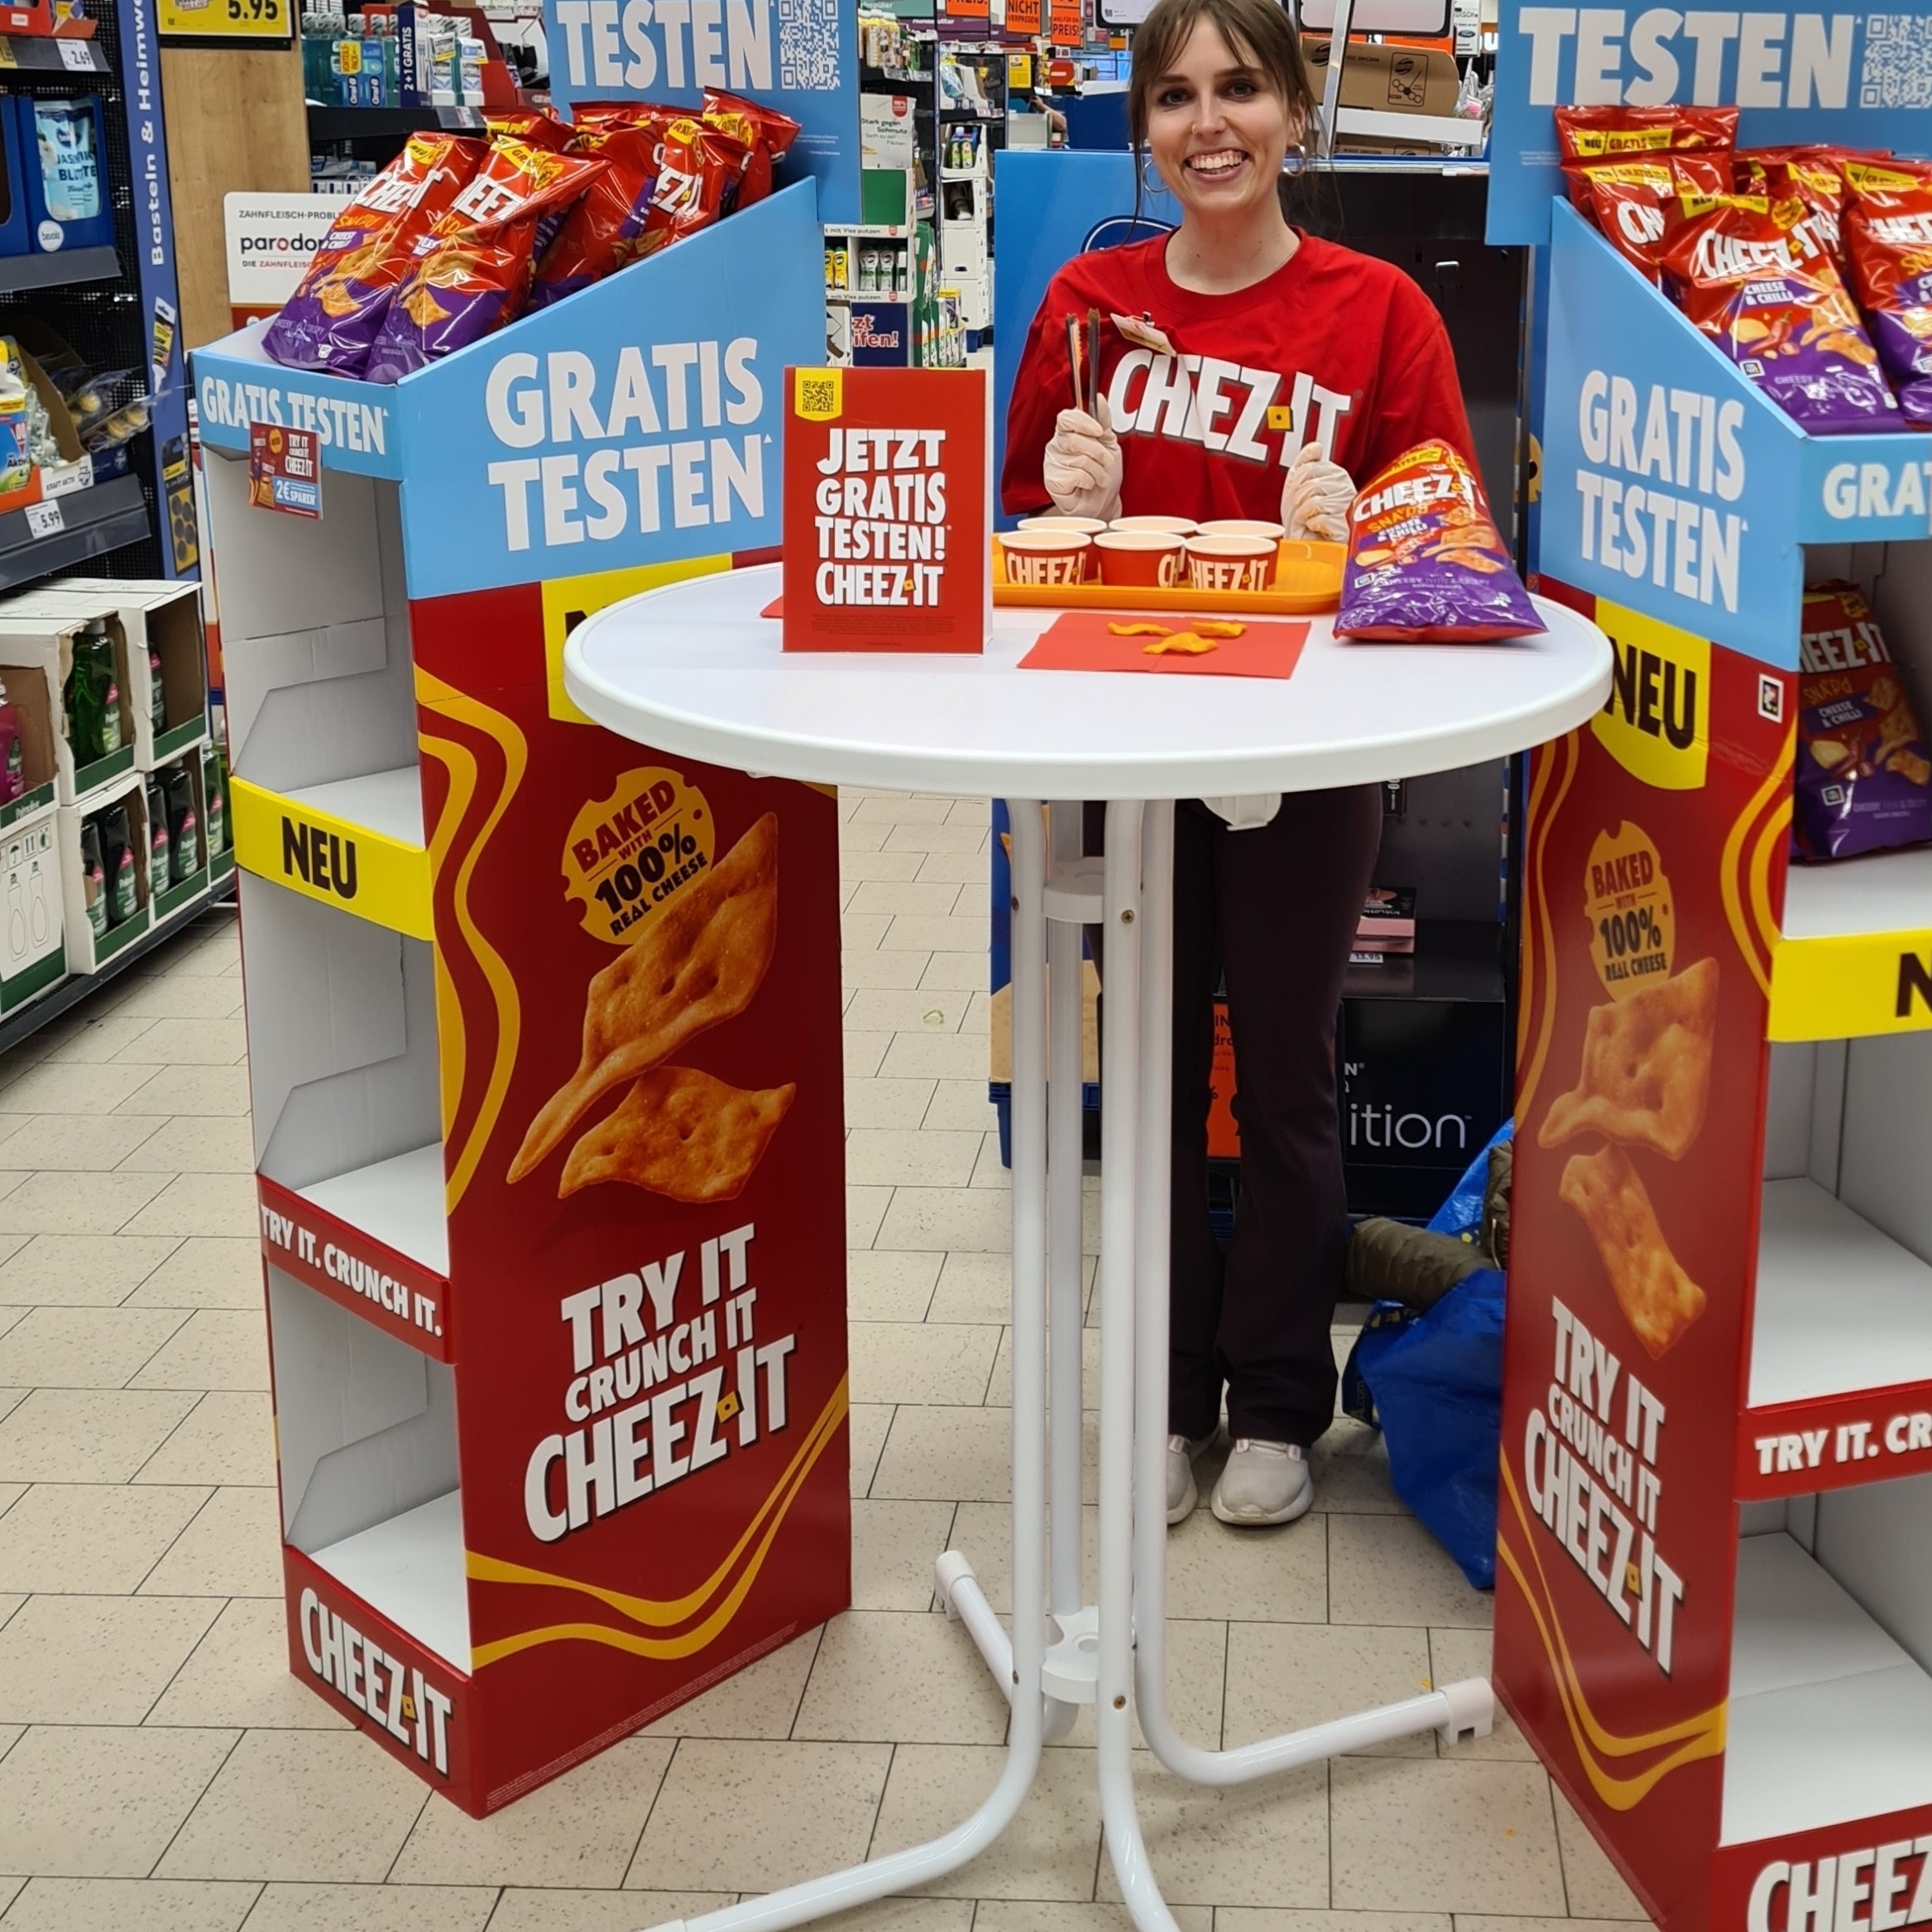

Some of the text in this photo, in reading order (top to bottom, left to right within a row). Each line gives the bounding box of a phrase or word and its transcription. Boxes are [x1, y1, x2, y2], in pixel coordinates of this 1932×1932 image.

[228, 0, 278, 20] 5.95
[402, 26, 414, 67] GRATIS
[556, 0, 773, 90] TESTEN
[1007, 0, 1038, 14] NICHT
[1052, 24, 1080, 36] PREIS!
[1519, 7, 1854, 108] TESTEN
[141, 121, 155, 144] &
[1584, 138, 1602, 150] NEU
[1608, 137, 1647, 151] GRATIS
[145, 154, 165, 266] Basteln
[201, 376, 282, 429] GRATIS
[288, 391, 386, 455] TESTEN
[486, 337, 763, 448] GRATIS
[816, 428, 946, 475] JETZT
[1580, 370, 1745, 501] GRATIS
[41, 511, 60, 530] 5.99
[487, 434, 765, 552] TESTEN
[816, 472, 946, 525] GRATIS
[1577, 469, 1743, 614] TESTEN
[1604, 635, 1697, 750] NEU
[1818, 700, 1854, 719] CHEESE
[282, 815, 358, 899] NEU
[571, 779, 676, 875] BAKED
[618, 829, 653, 861] WITH
[594, 822, 697, 915] 100%
[609, 851, 708, 937] REAL CHEESE
[1591, 850, 1654, 899] BAKED
[1599, 904, 1662, 959] 100%
[1605, 952, 1668, 982] REAL CHEESE
[1350, 1103, 1466, 1148] ition
[261, 1203, 443, 1338] TRY IT. CRUNCH IT.
[561, 1222, 754, 1374] TRY IT
[565, 1287, 756, 1422] CRUNCH IT
[1552, 1295, 1666, 1466] TRY IT
[1548, 1383, 1661, 1533] CRUNCH IT
[1755, 1429, 1829, 1475] TRY
[1836, 1421, 1880, 1463] IT.
